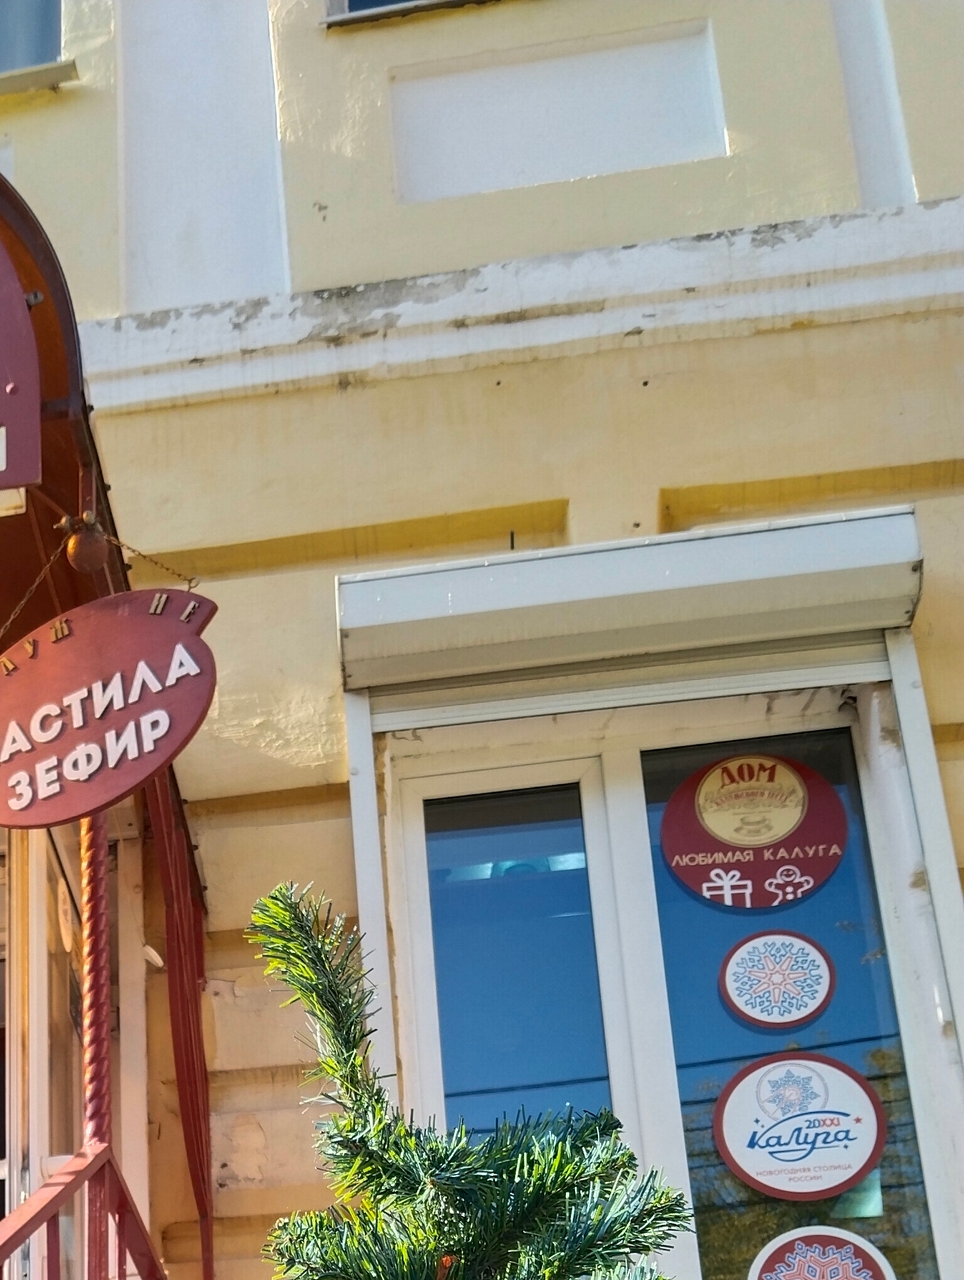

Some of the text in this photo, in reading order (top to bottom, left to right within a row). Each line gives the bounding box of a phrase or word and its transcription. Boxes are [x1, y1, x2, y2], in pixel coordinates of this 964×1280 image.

[6, 708, 171, 812] ЗЕФИР
[720, 762, 778, 789] ДОМ
[671, 843, 843, 868] ЛЮБИМАЯ КАЛУГА
[788, 1174, 824, 1184] РОССИИ
[812, 1163, 854, 1175] СТОЛИЦА
